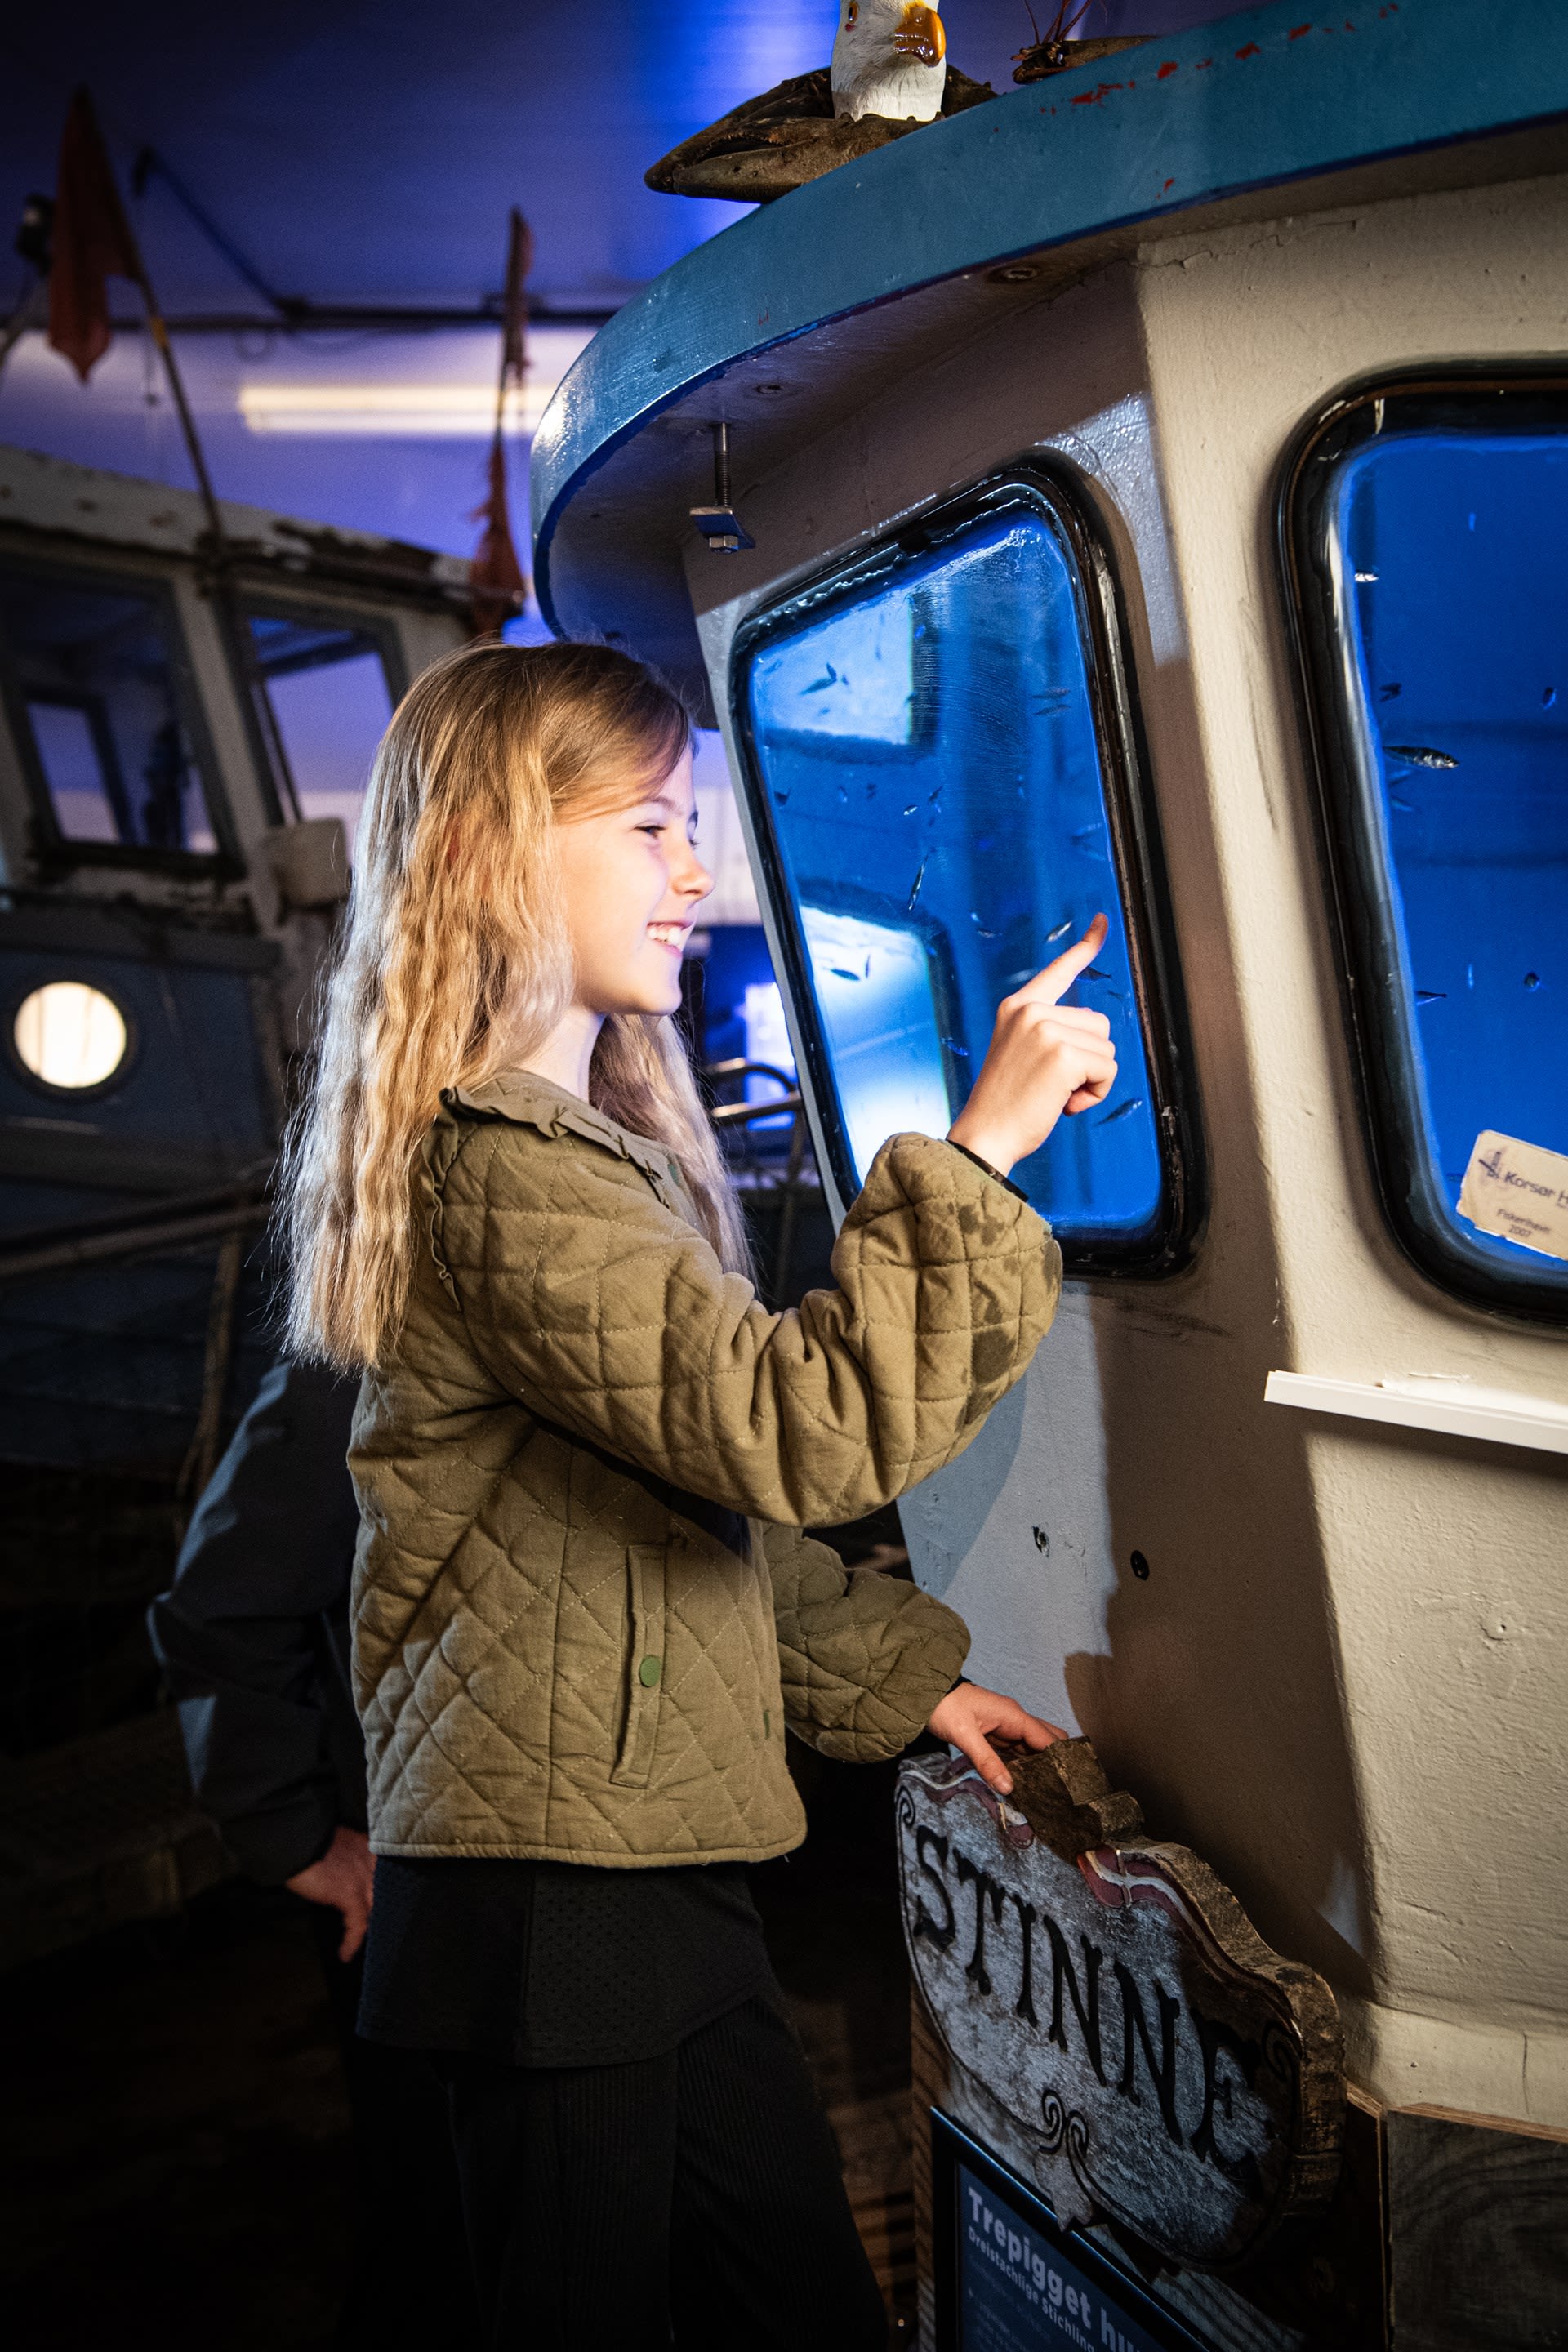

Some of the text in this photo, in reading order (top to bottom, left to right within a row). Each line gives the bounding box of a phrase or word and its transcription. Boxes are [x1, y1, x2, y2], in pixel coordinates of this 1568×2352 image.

[914, 1824, 1263, 2197] STINNE
[969, 2186, 1092, 2329] Trepigget
[969, 2225, 1039, 2305] Dreistachlige
